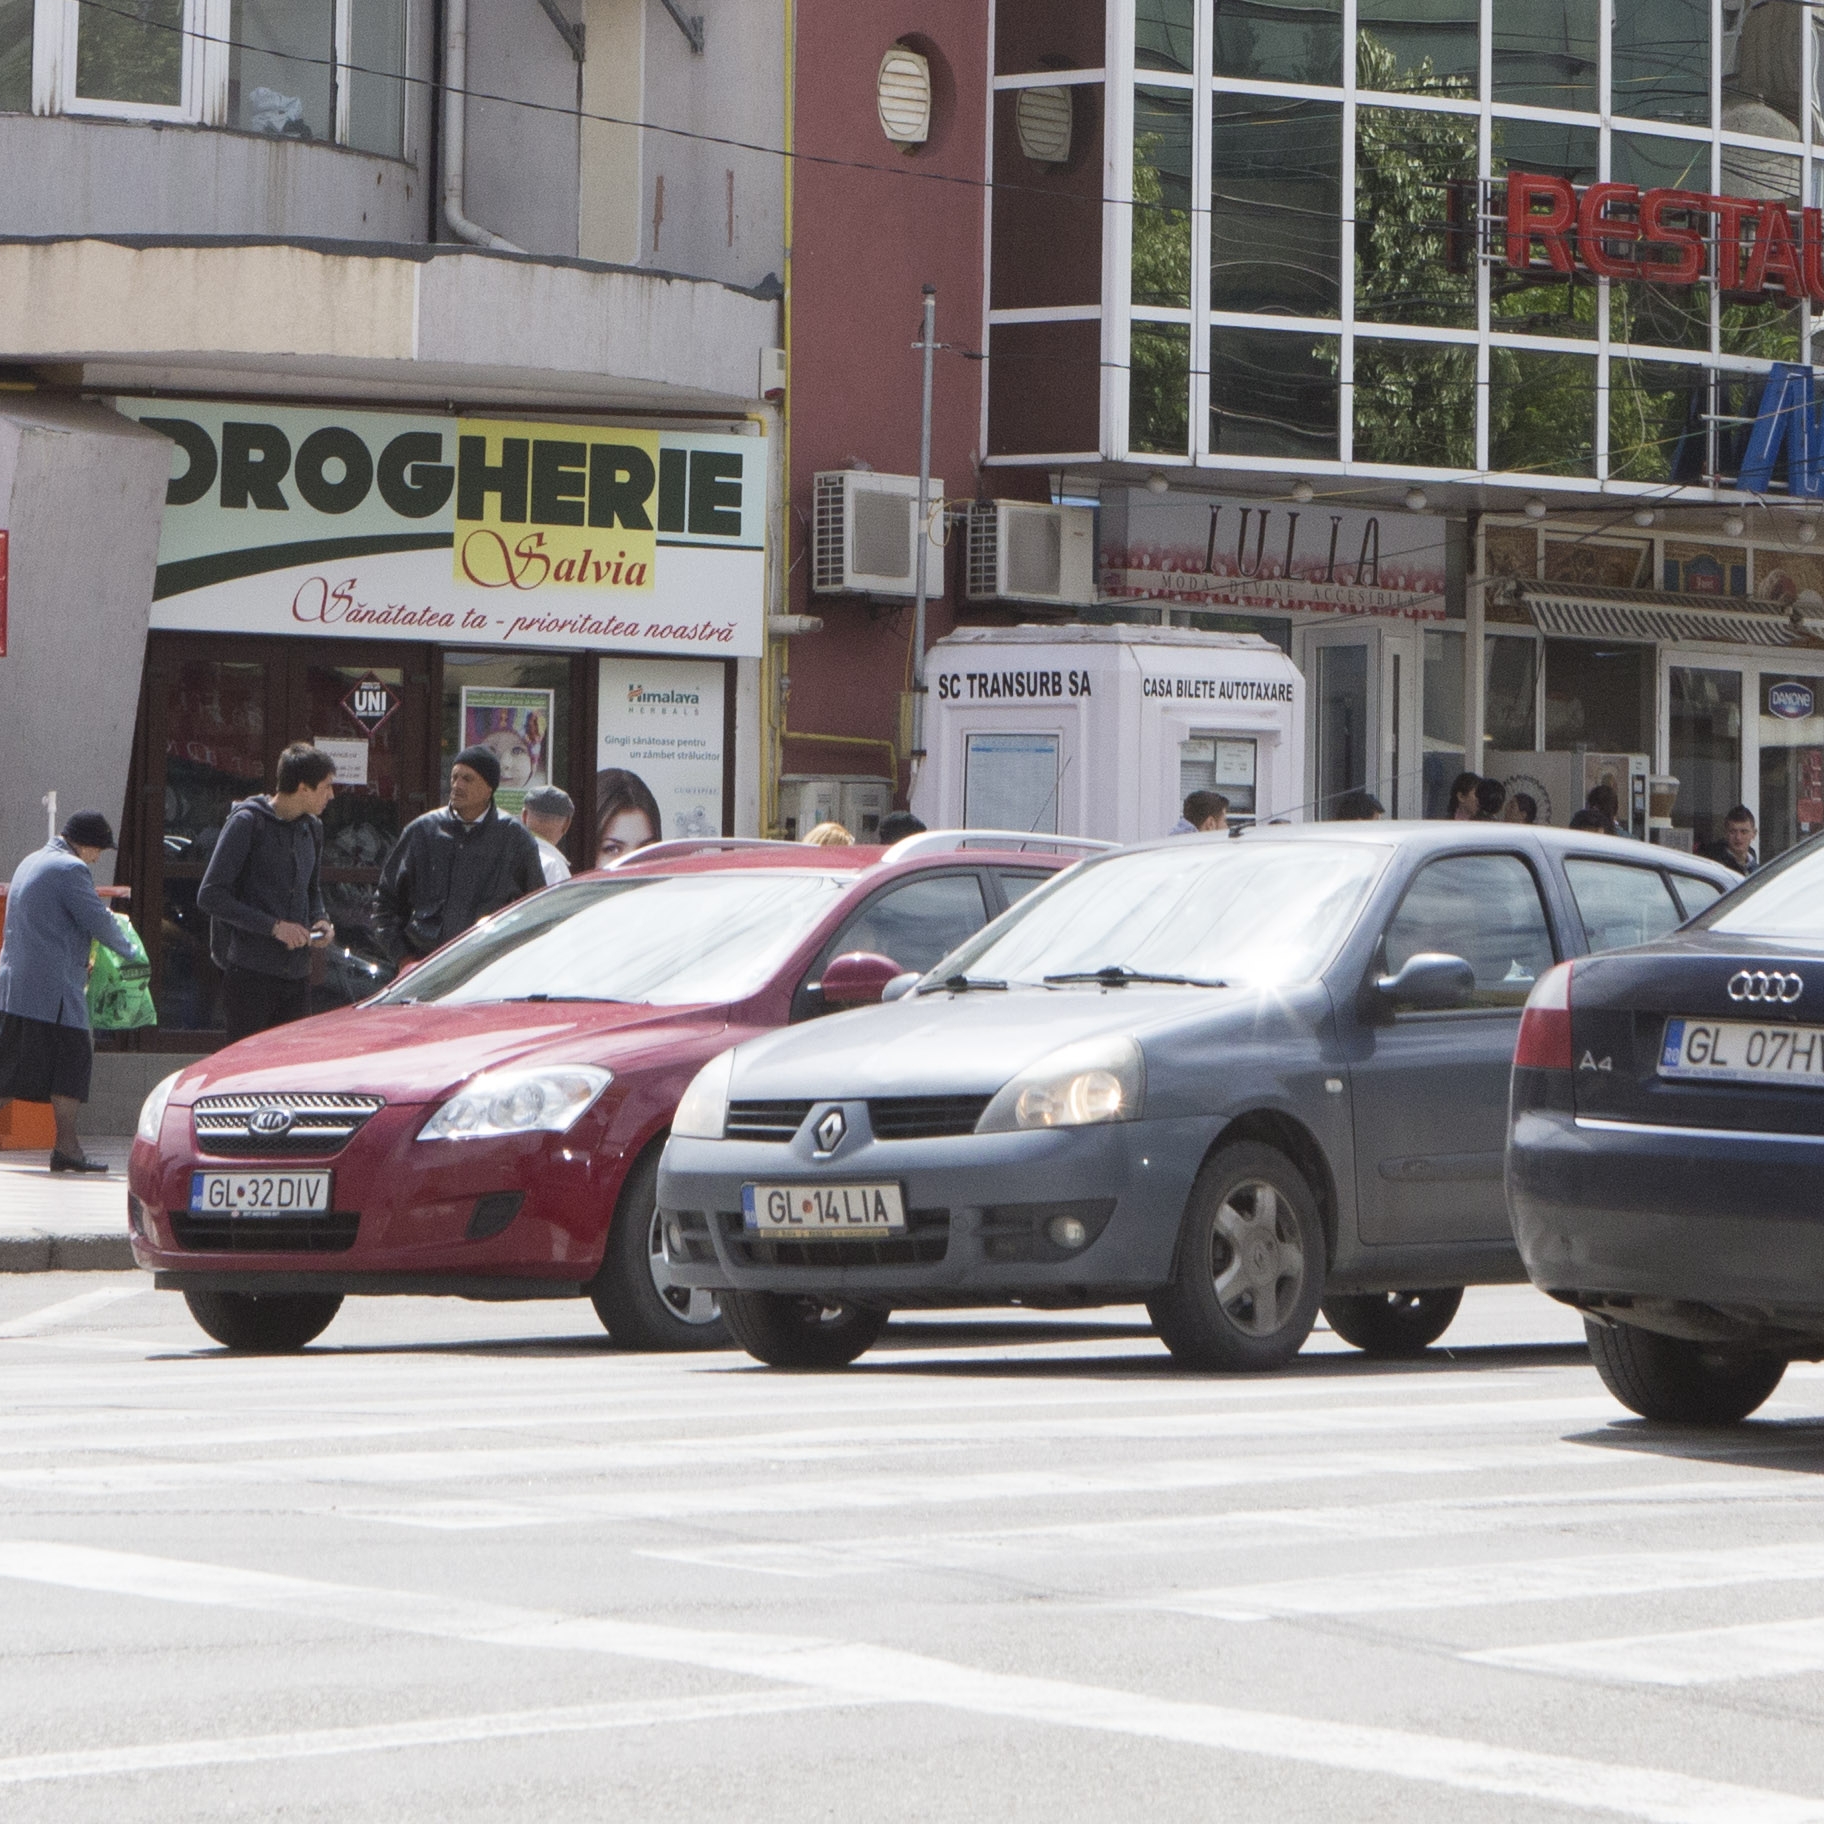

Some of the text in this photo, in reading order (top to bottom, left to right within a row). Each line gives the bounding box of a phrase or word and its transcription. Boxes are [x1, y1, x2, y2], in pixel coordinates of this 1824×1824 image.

[138, 416, 743, 537] DROGHERIE
[1202, 504, 1380, 587] IULIA
[461, 529, 647, 590] Salvia
[1161, 575, 1210, 591] MODA
[1229, 579, 1294, 598] DEVINE
[291, 576, 456, 626] Sănătatea
[462, 609, 487, 629] ta
[505, 609, 640, 640] prioritatea
[644, 619, 736, 644] noastră
[628, 684, 700, 705] Himalaya
[938, 670, 1092, 699] SC TRANSURB SA
[1143, 678, 1294, 703] CASA BILETE AUTOTAXARE
[354, 691, 387, 711] UNI
[629, 751, 641, 759] un
[677, 738, 707, 750] pentru
[1686, 1027, 1727, 1066] GL
[1579, 1050, 1613, 1072] A4
[256, 1113, 283, 1127] KIA
[209, 1178, 237, 1207] GL
[768, 1191, 803, 1224] GL
